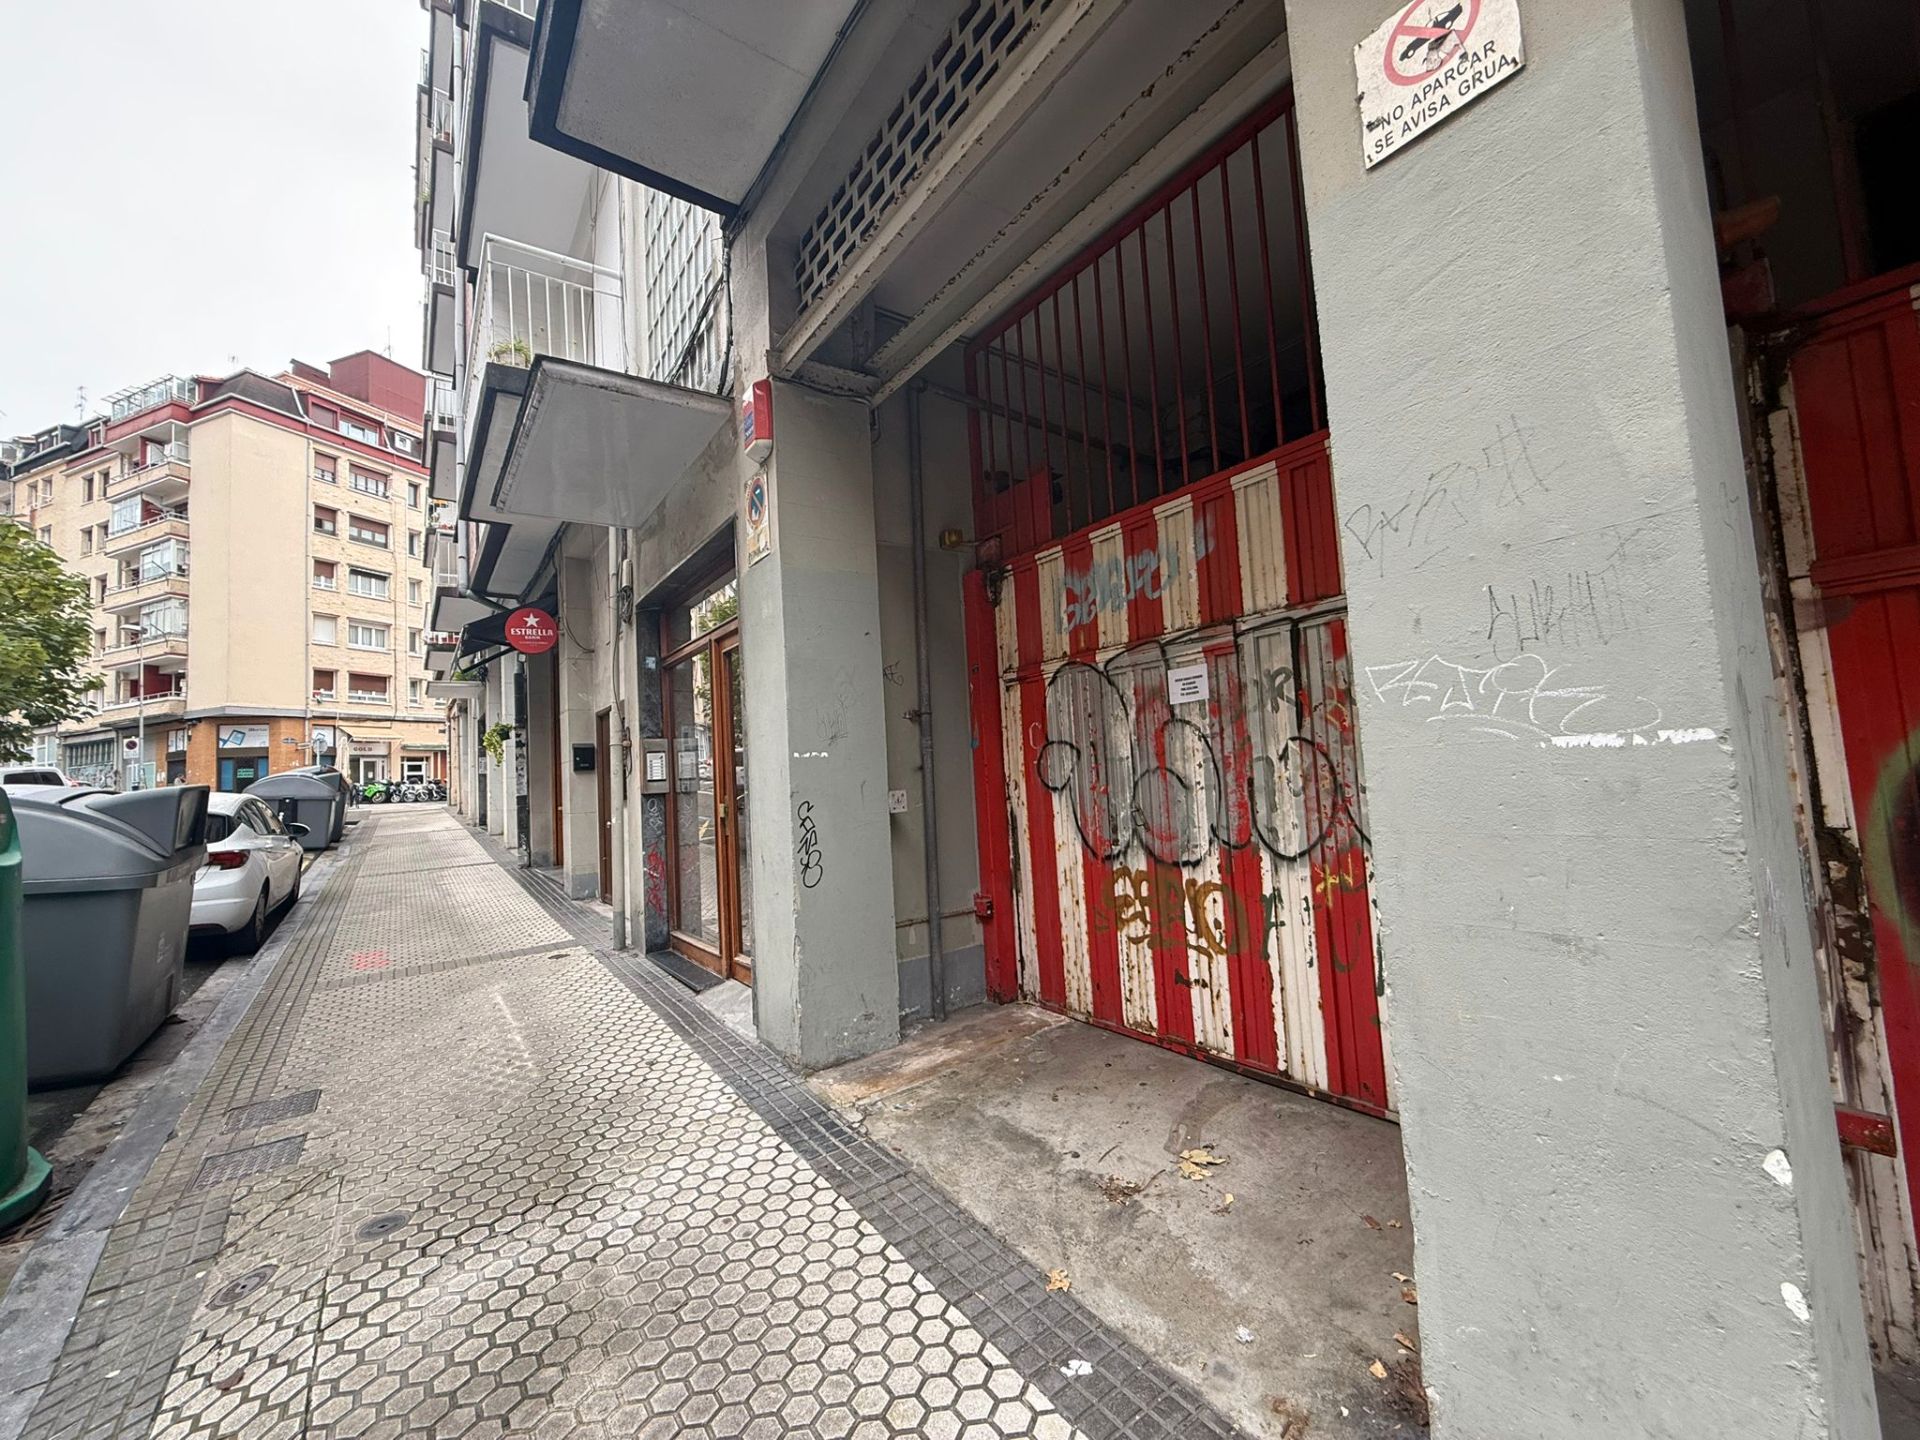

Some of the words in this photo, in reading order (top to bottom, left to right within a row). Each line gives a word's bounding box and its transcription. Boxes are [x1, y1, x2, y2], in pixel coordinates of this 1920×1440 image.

[1374, 131, 1395, 154] SE
[1401, 94, 1451, 137] AVISA
[1458, 54, 1512, 97] GRUA
[1381, 104, 1404, 130] NO
[1411, 39, 1497, 110] APARCAR
[511, 628, 553, 636] ESTRELLA
